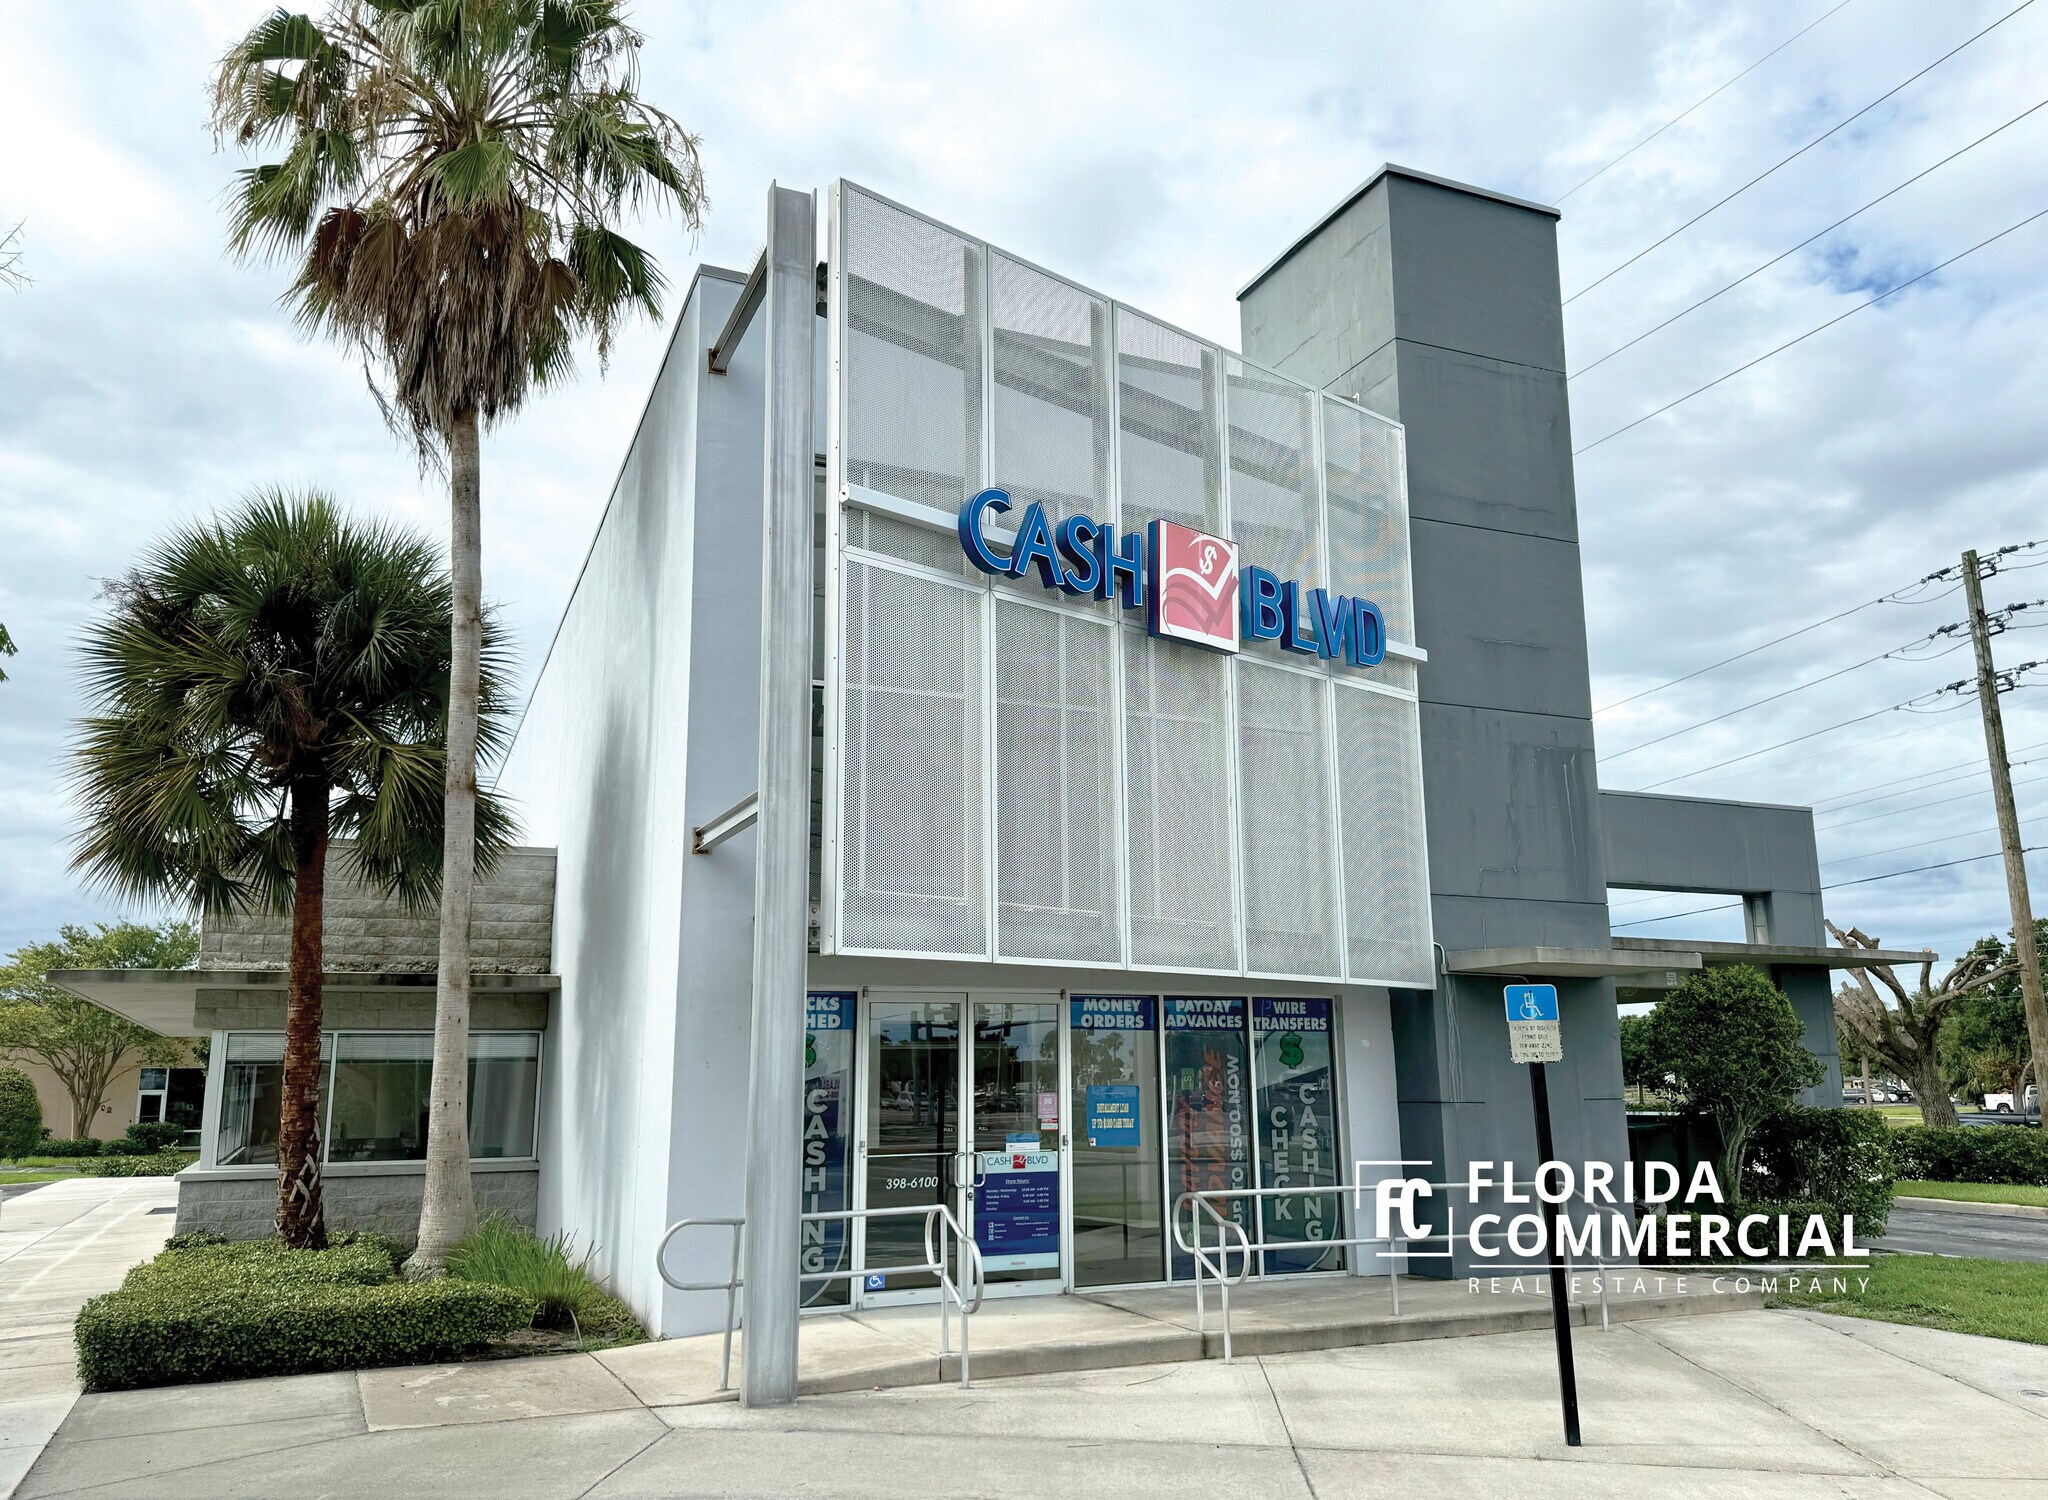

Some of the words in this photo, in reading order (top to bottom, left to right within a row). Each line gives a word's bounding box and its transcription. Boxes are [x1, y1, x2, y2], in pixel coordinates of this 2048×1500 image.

[958, 487, 1142, 609] CASH
[1241, 565, 1386, 668] BLVD
[1083, 998, 1143, 1012] MONEY
[1175, 1000, 1233, 1013] PAYDAY
[1272, 1001, 1307, 1015] WIRE
[1080, 1014, 1144, 1028] ORDERS
[1165, 1014, 1243, 1028] ADVANCES
[1253, 1016, 1328, 1031] TRANSFERS
[1226, 1054, 1241, 1104] NOW
[1229, 1109, 1244, 1162] $500
[986, 1156, 1012, 1166] CASH
[1026, 1155, 1049, 1165] BLVD
[1270, 1105, 1294, 1221] CHECK
[1298, 1082, 1325, 1242] CASHING
[885, 1176, 939, 1190] 398-6100
